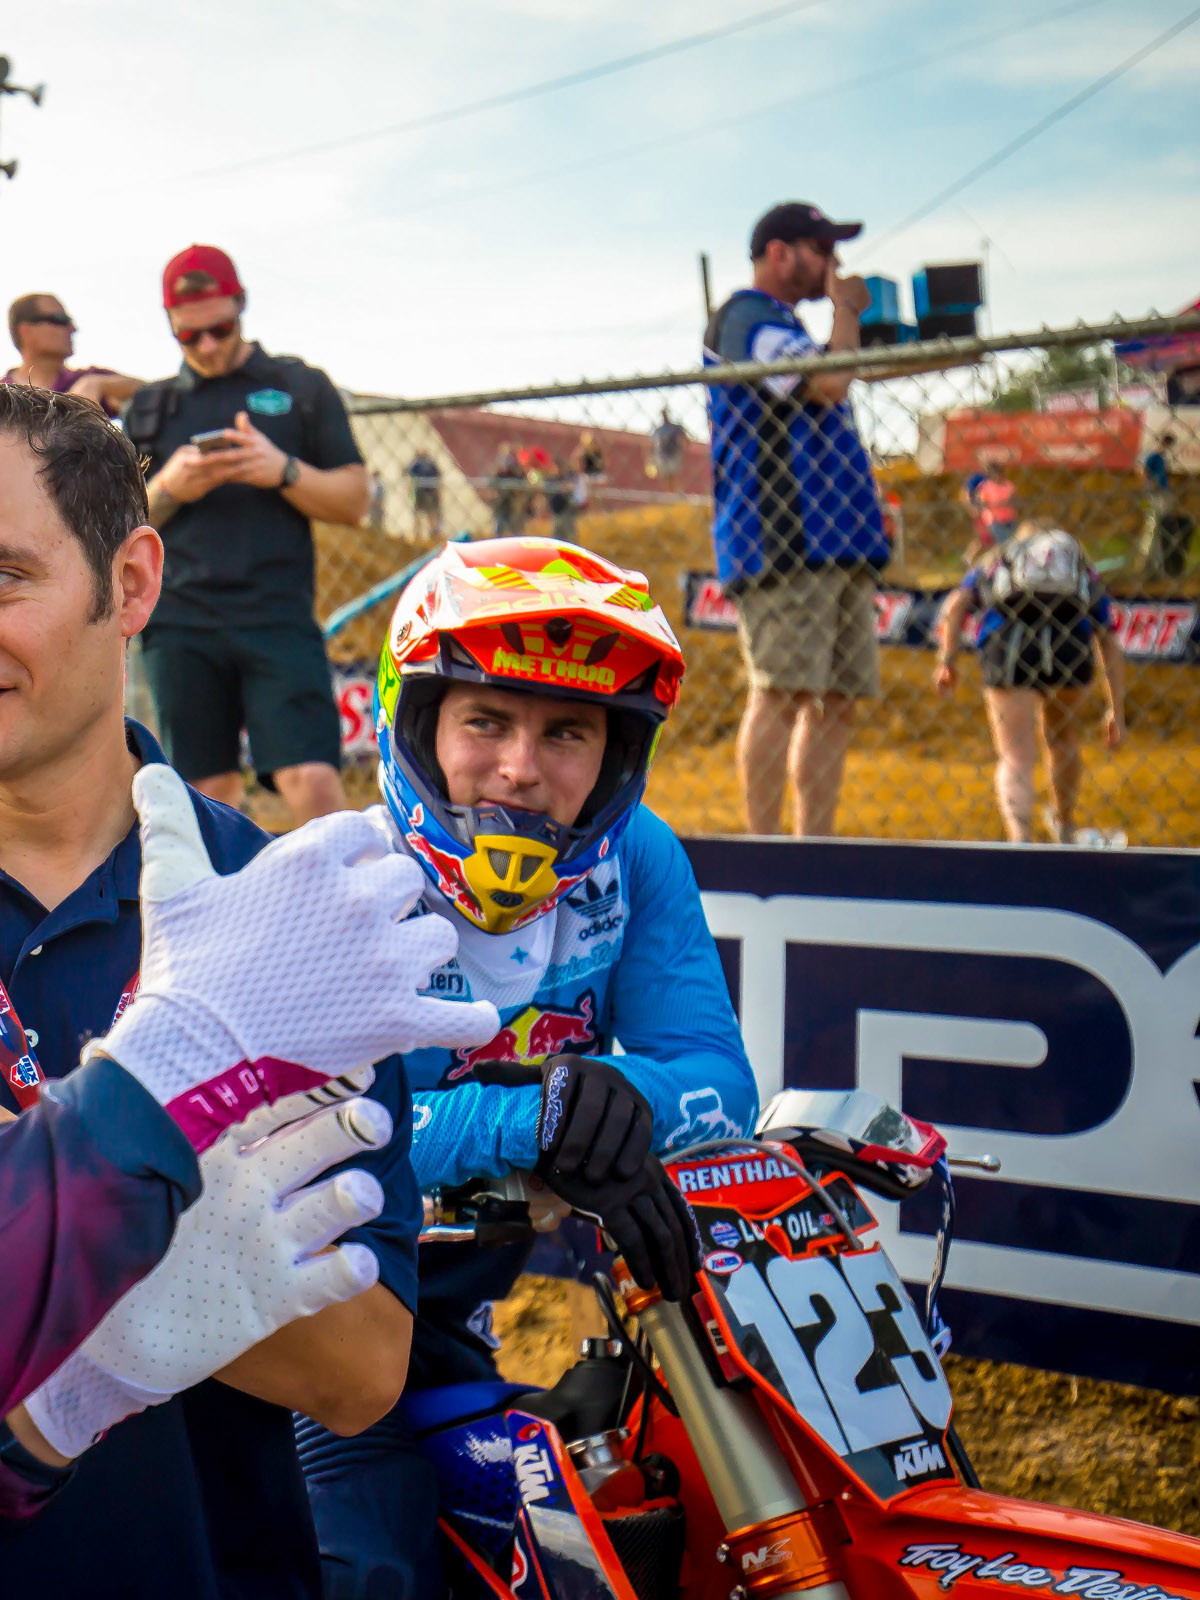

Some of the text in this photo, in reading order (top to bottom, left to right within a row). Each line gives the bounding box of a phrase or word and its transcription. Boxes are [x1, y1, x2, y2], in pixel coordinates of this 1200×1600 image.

[492, 649, 616, 687] METHOD
[677, 1157, 798, 1193] RENTHAL
[786, 1210, 819, 1241] OIL
[723, 1251, 953, 1456] 123
[513, 1443, 555, 1507] KTM
[893, 1440, 947, 1482] KTM
[900, 1544, 984, 1587] Troy
[976, 1553, 1052, 1584] Lee
